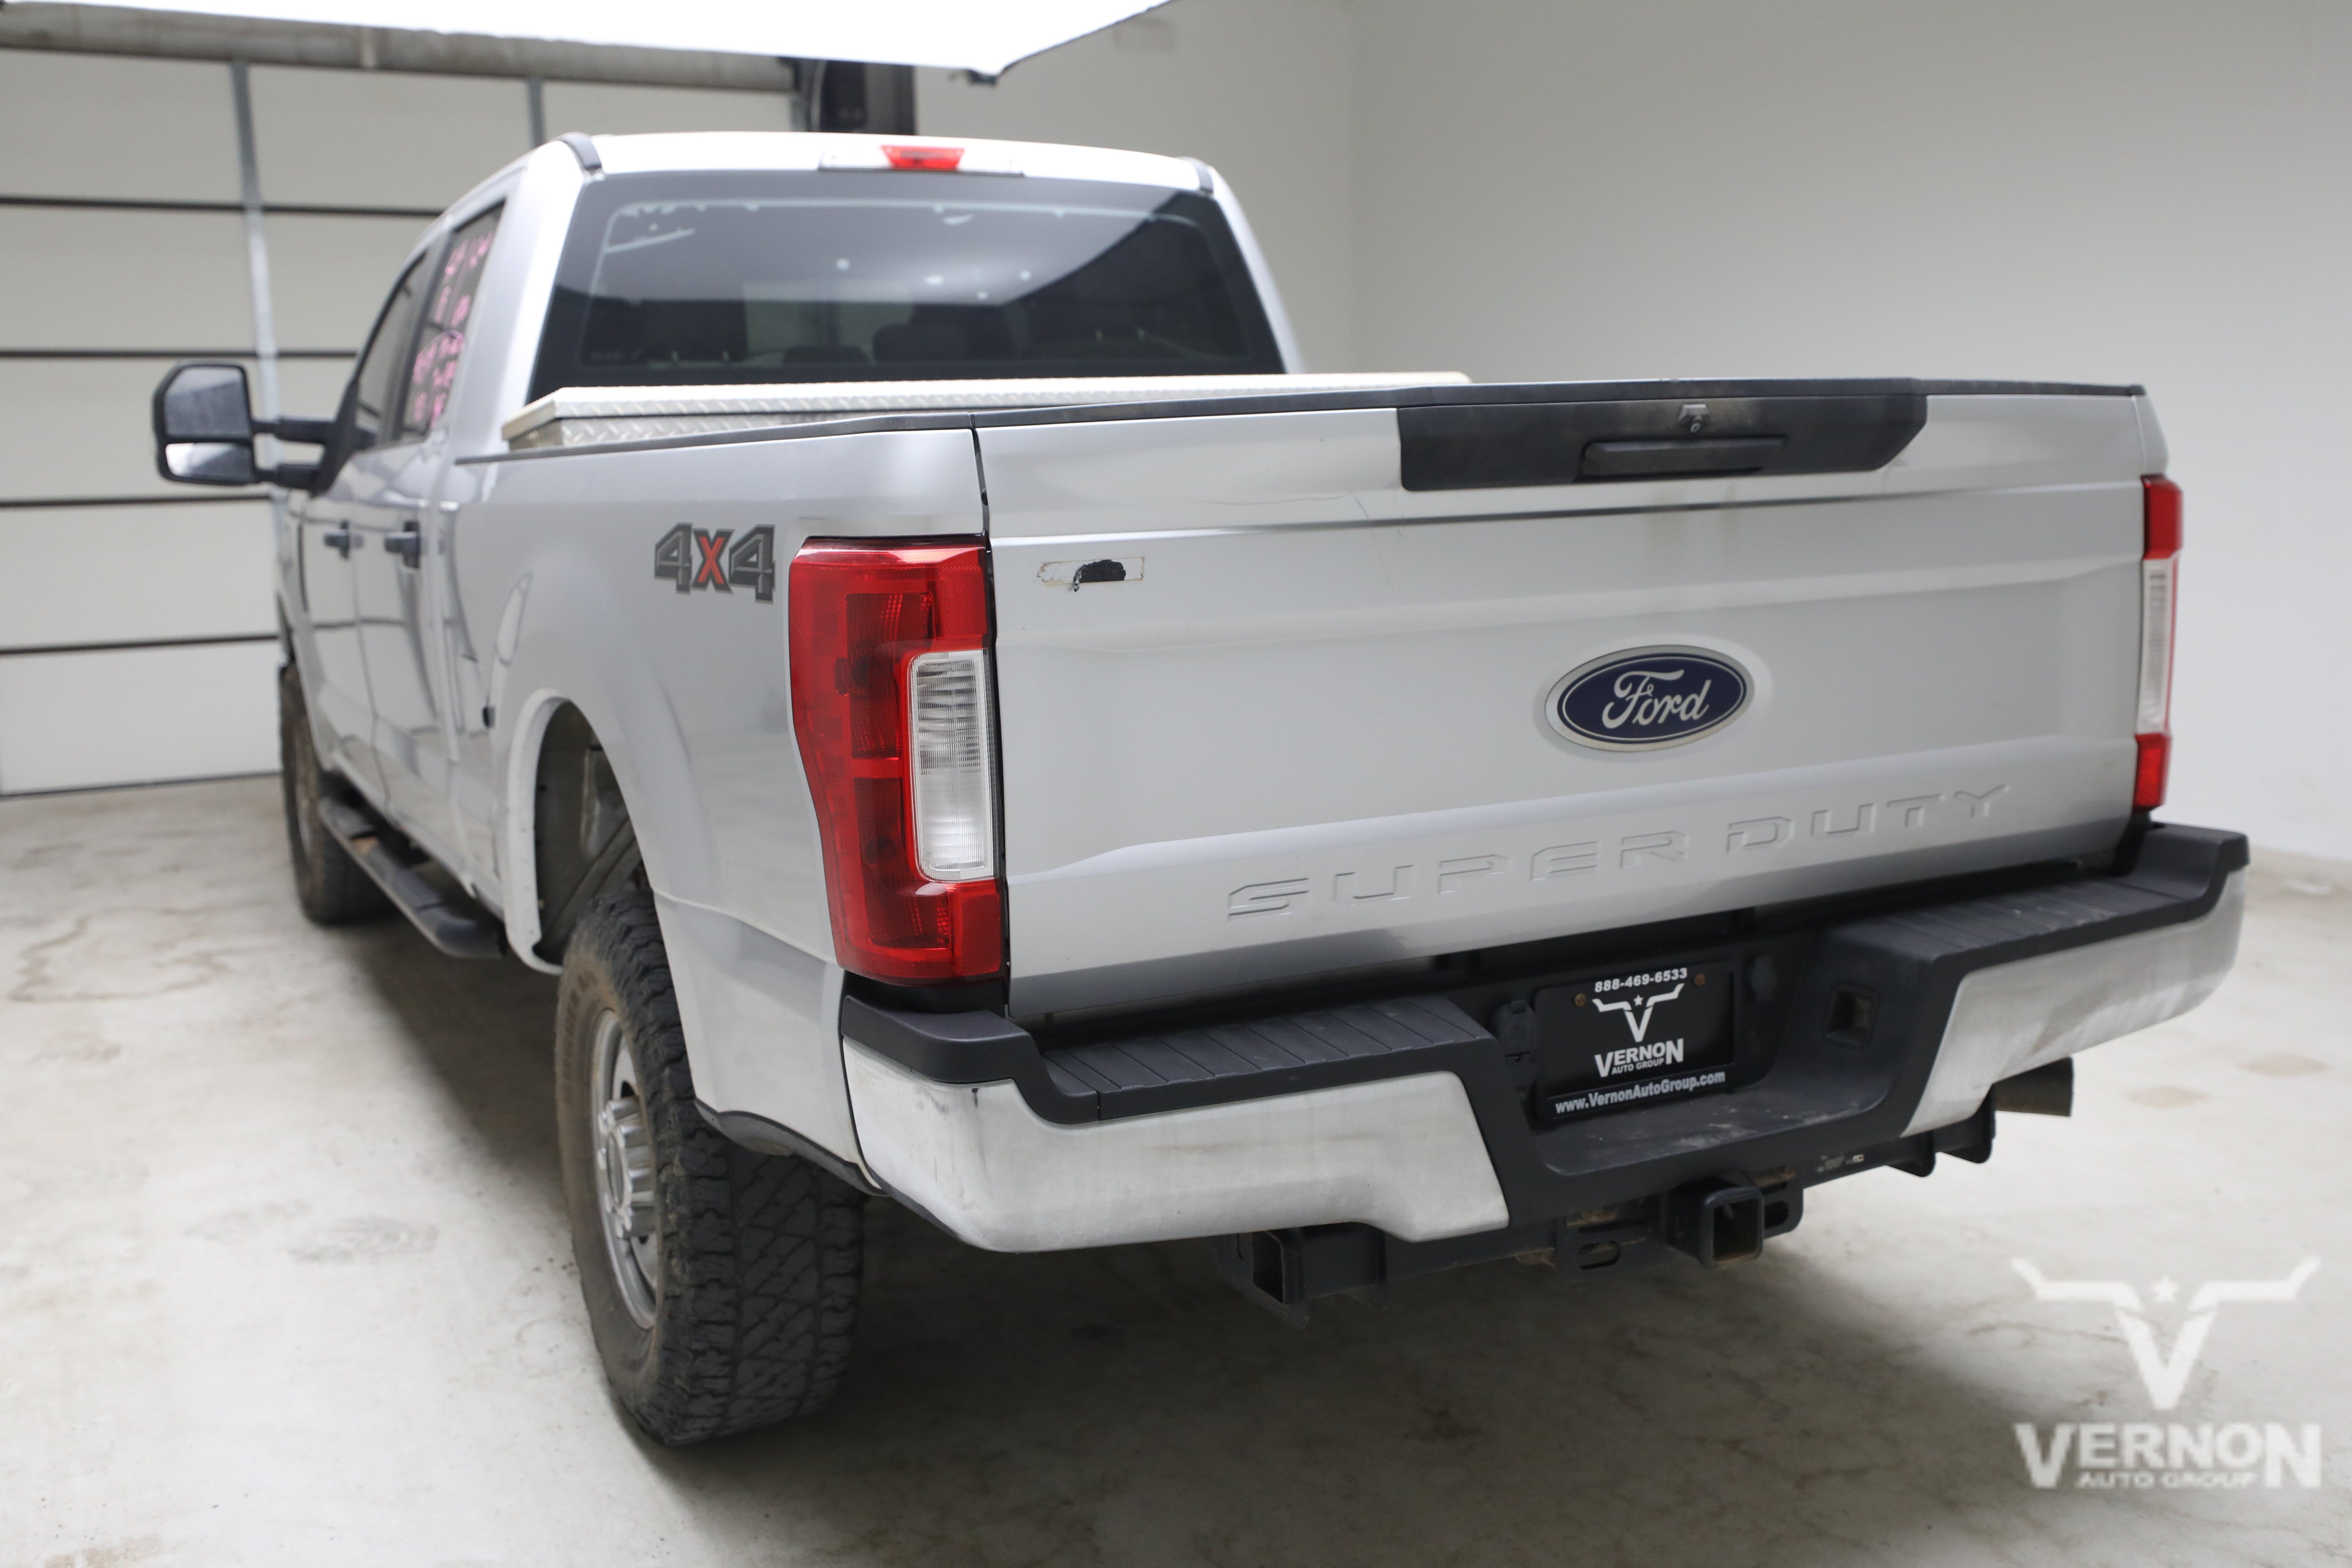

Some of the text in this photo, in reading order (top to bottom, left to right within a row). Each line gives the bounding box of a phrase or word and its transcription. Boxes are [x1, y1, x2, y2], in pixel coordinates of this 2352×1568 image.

[1602, 669, 1711, 729] Ford
[1227, 784, 2010, 921] SUPER DUTY
[1594, 967, 1688, 993] 888-469-6533
[1595, 1038, 1684, 1078] VERNON
[1611, 1058, 1665, 1075] AUTO GROUP
[1555, 1071, 1726, 1114] www.VernonAutoGroup.com
